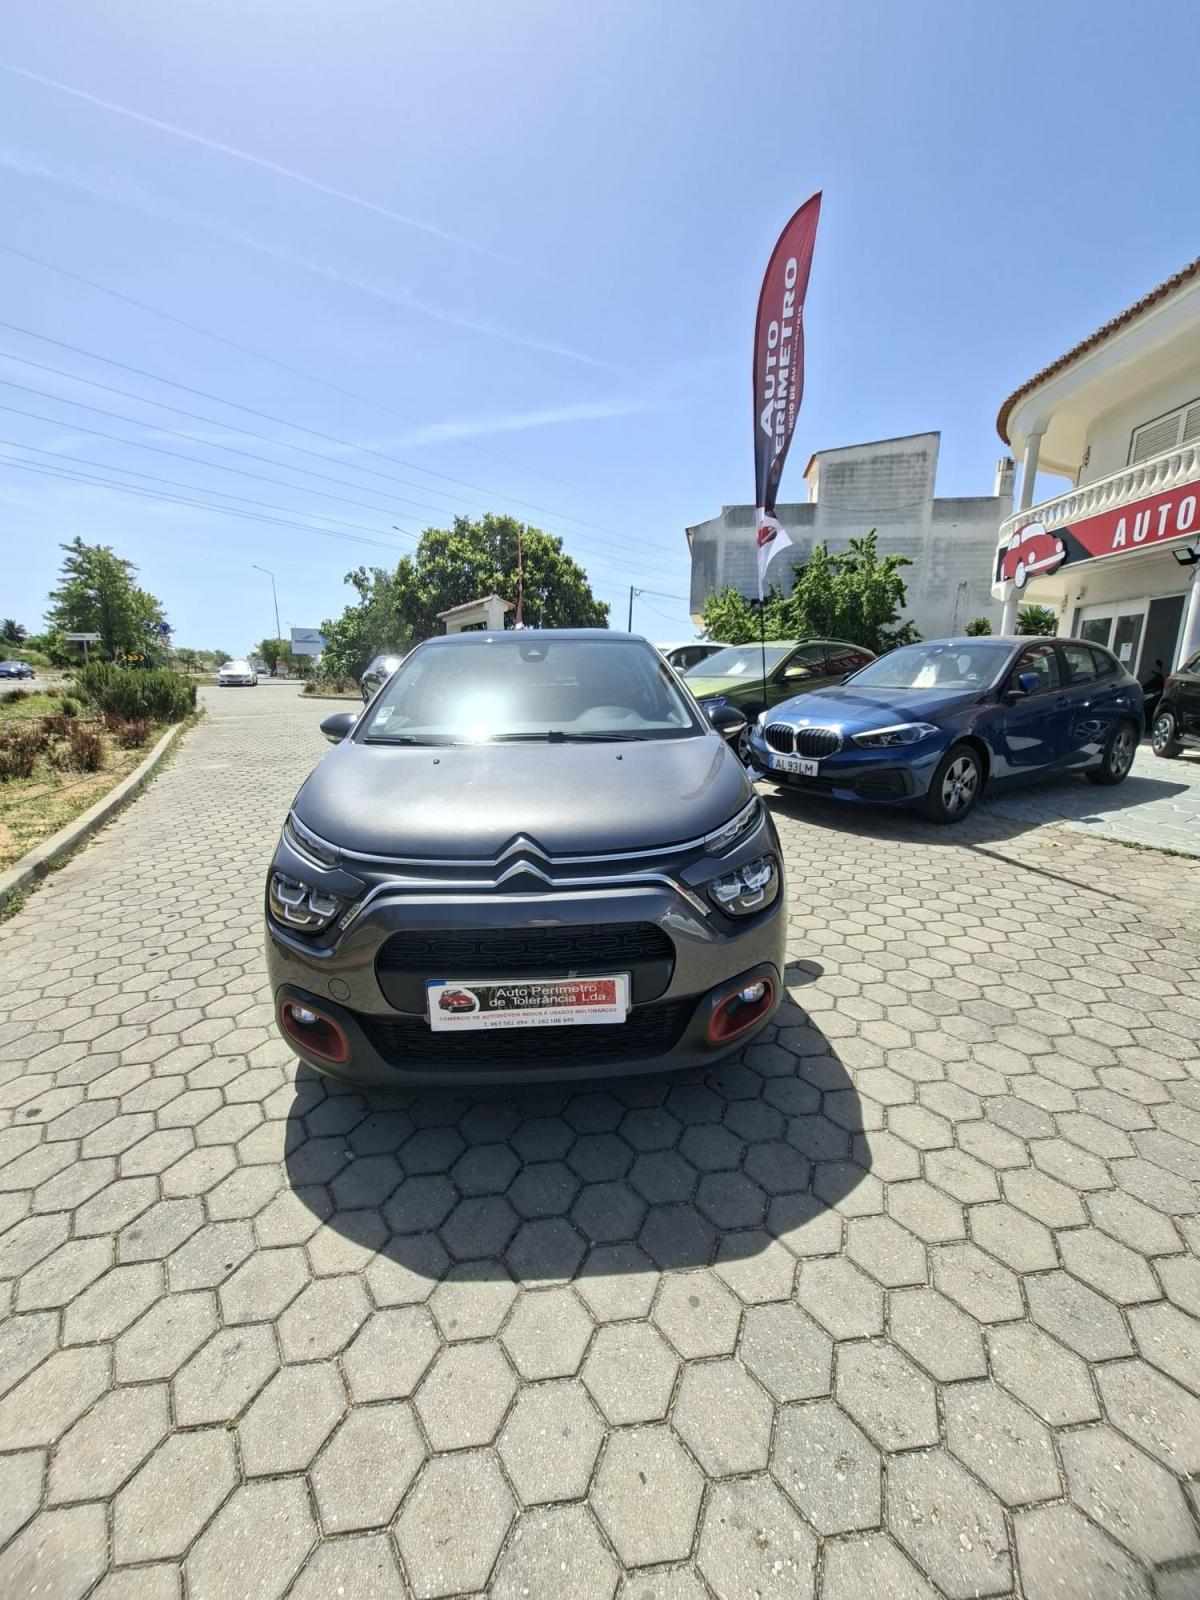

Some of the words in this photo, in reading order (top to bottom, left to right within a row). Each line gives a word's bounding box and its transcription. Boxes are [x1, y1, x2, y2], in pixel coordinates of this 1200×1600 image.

[760, 320, 779, 439] AUTO
[771, 257, 798, 467] ERÍMETRO
[1111, 495, 1197, 549] AUTO
[489, 998, 506, 1007] de
[496, 988, 528, 997] Auto
